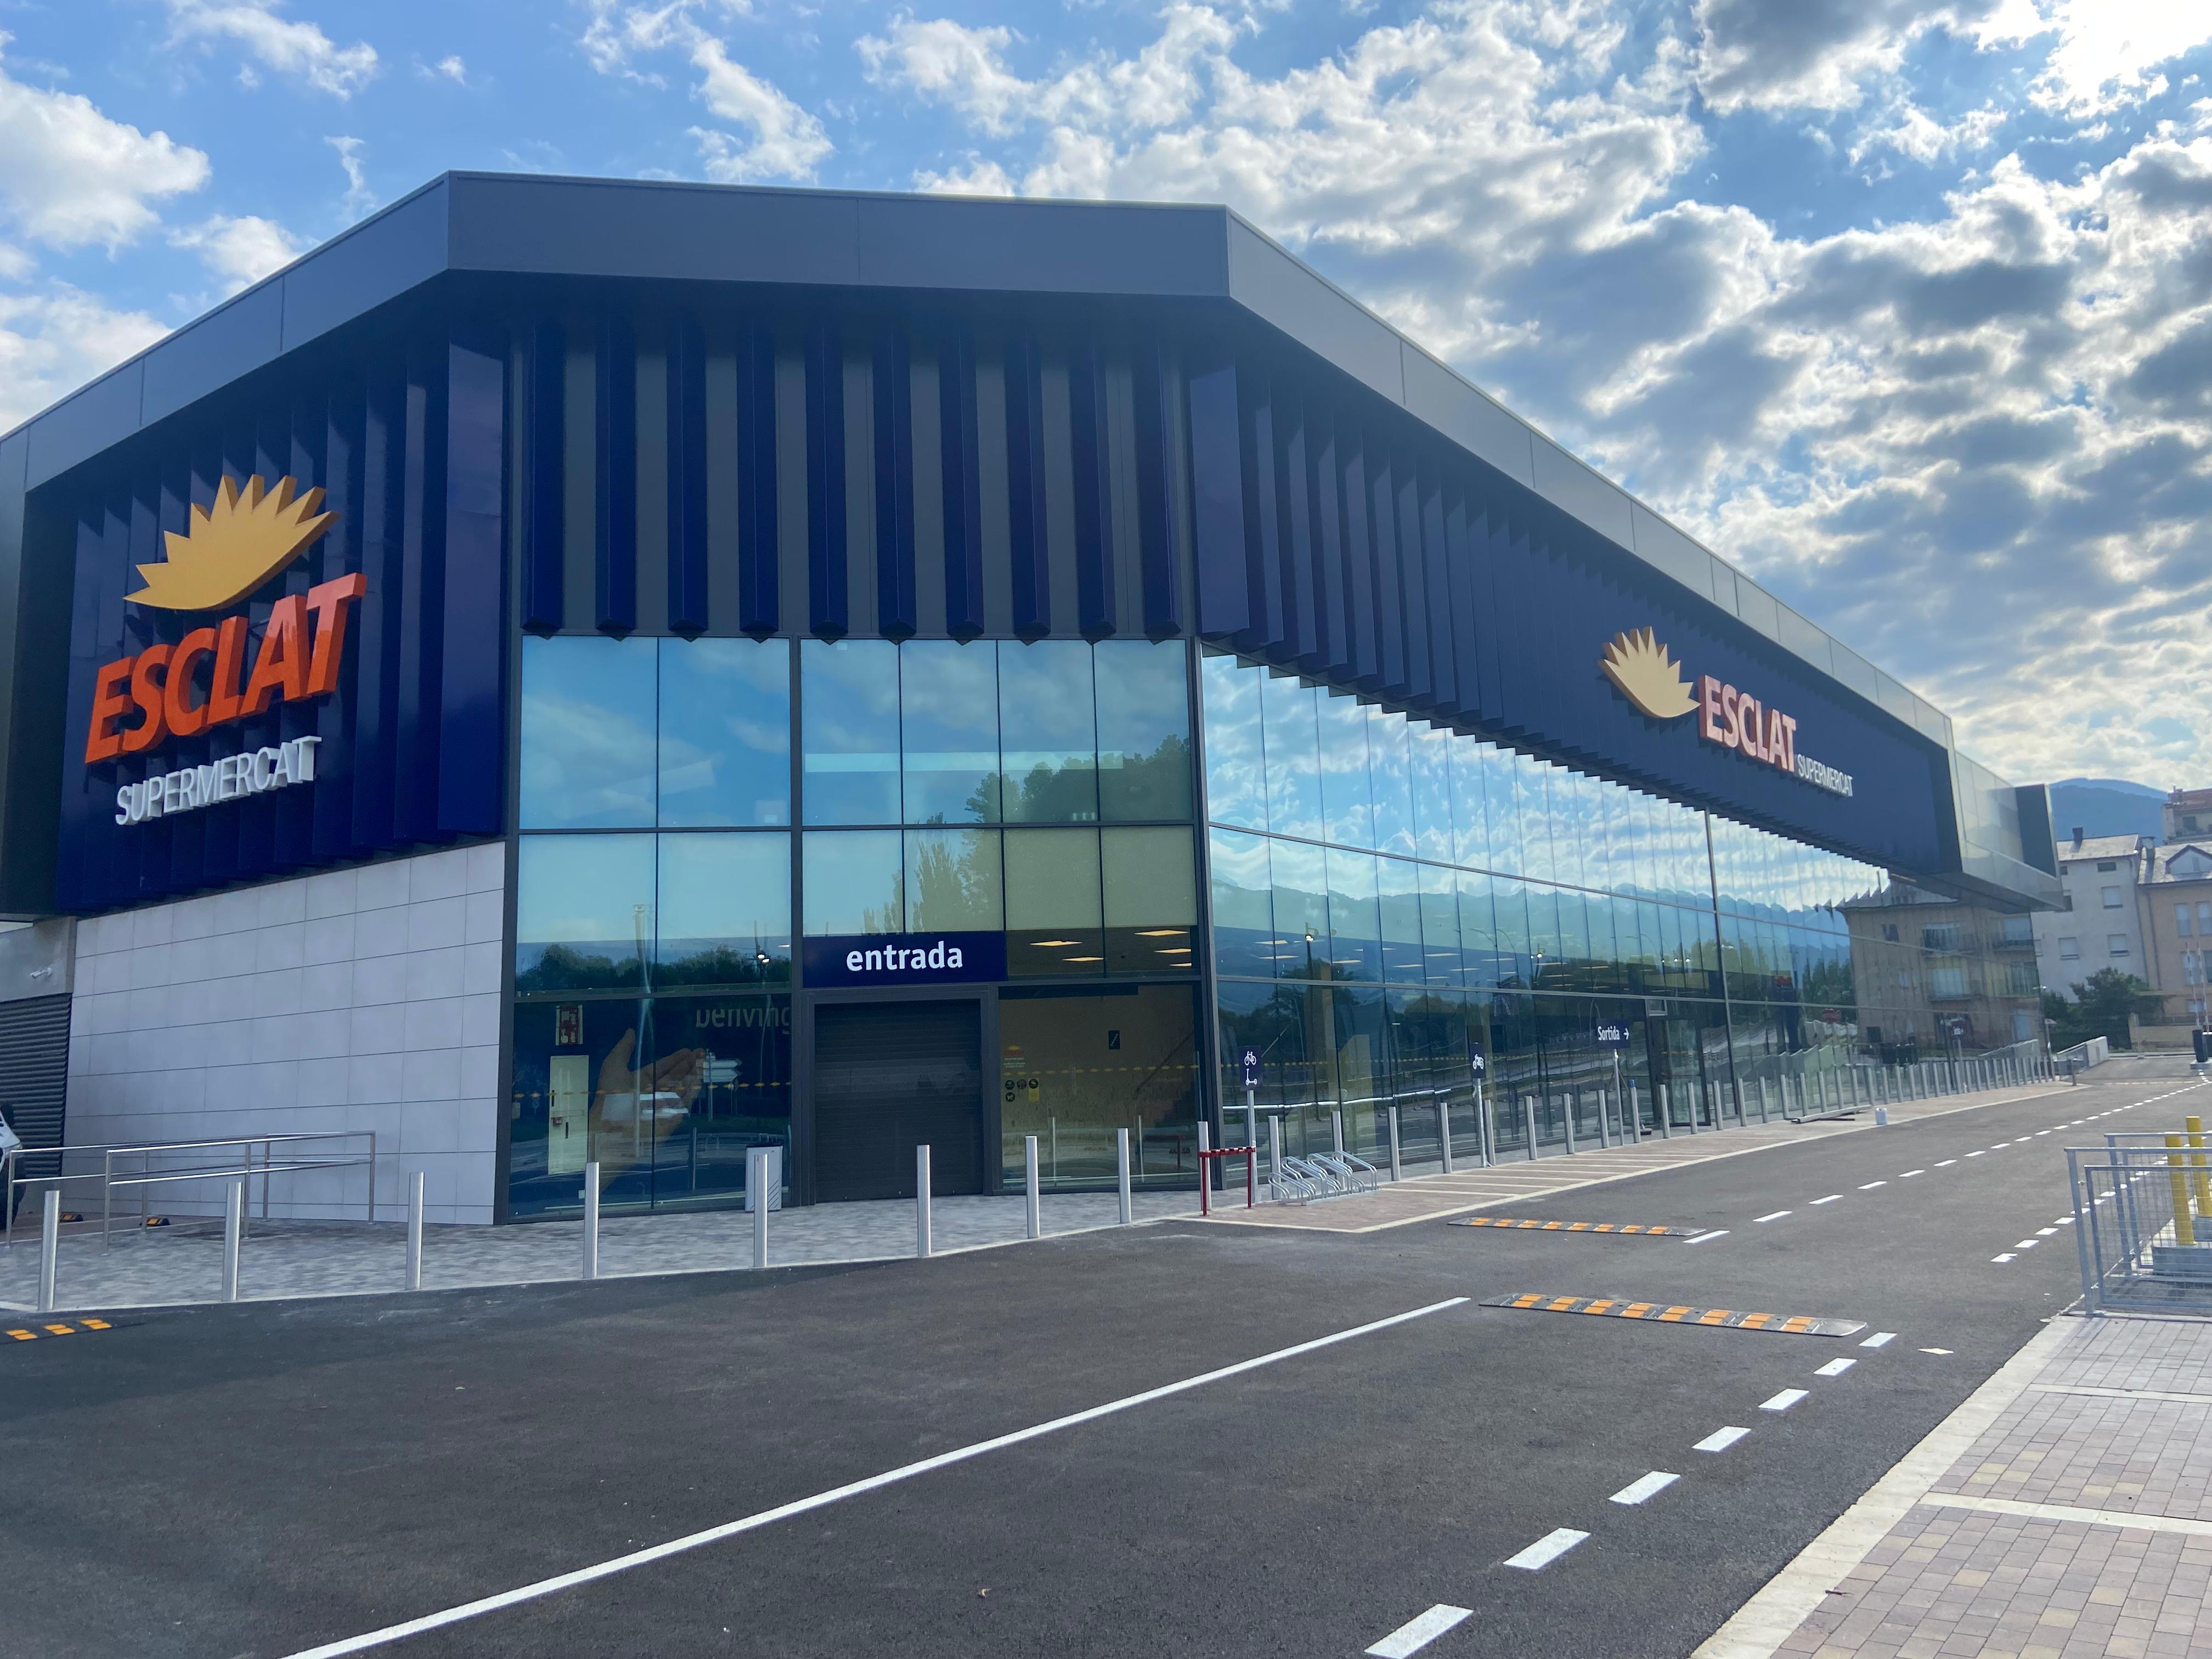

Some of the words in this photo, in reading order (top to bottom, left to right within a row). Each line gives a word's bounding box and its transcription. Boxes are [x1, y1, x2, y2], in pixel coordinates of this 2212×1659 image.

[85, 572, 367, 763] ESCLAT
[1699, 674, 1797, 772] ESCLAT
[1797, 753, 1853, 797] SUPERMERCAT
[115, 736, 322, 825] SUPERMERCAT
[847, 940, 963, 971] entrada
[1598, 1025, 1620, 1041] Sortida
